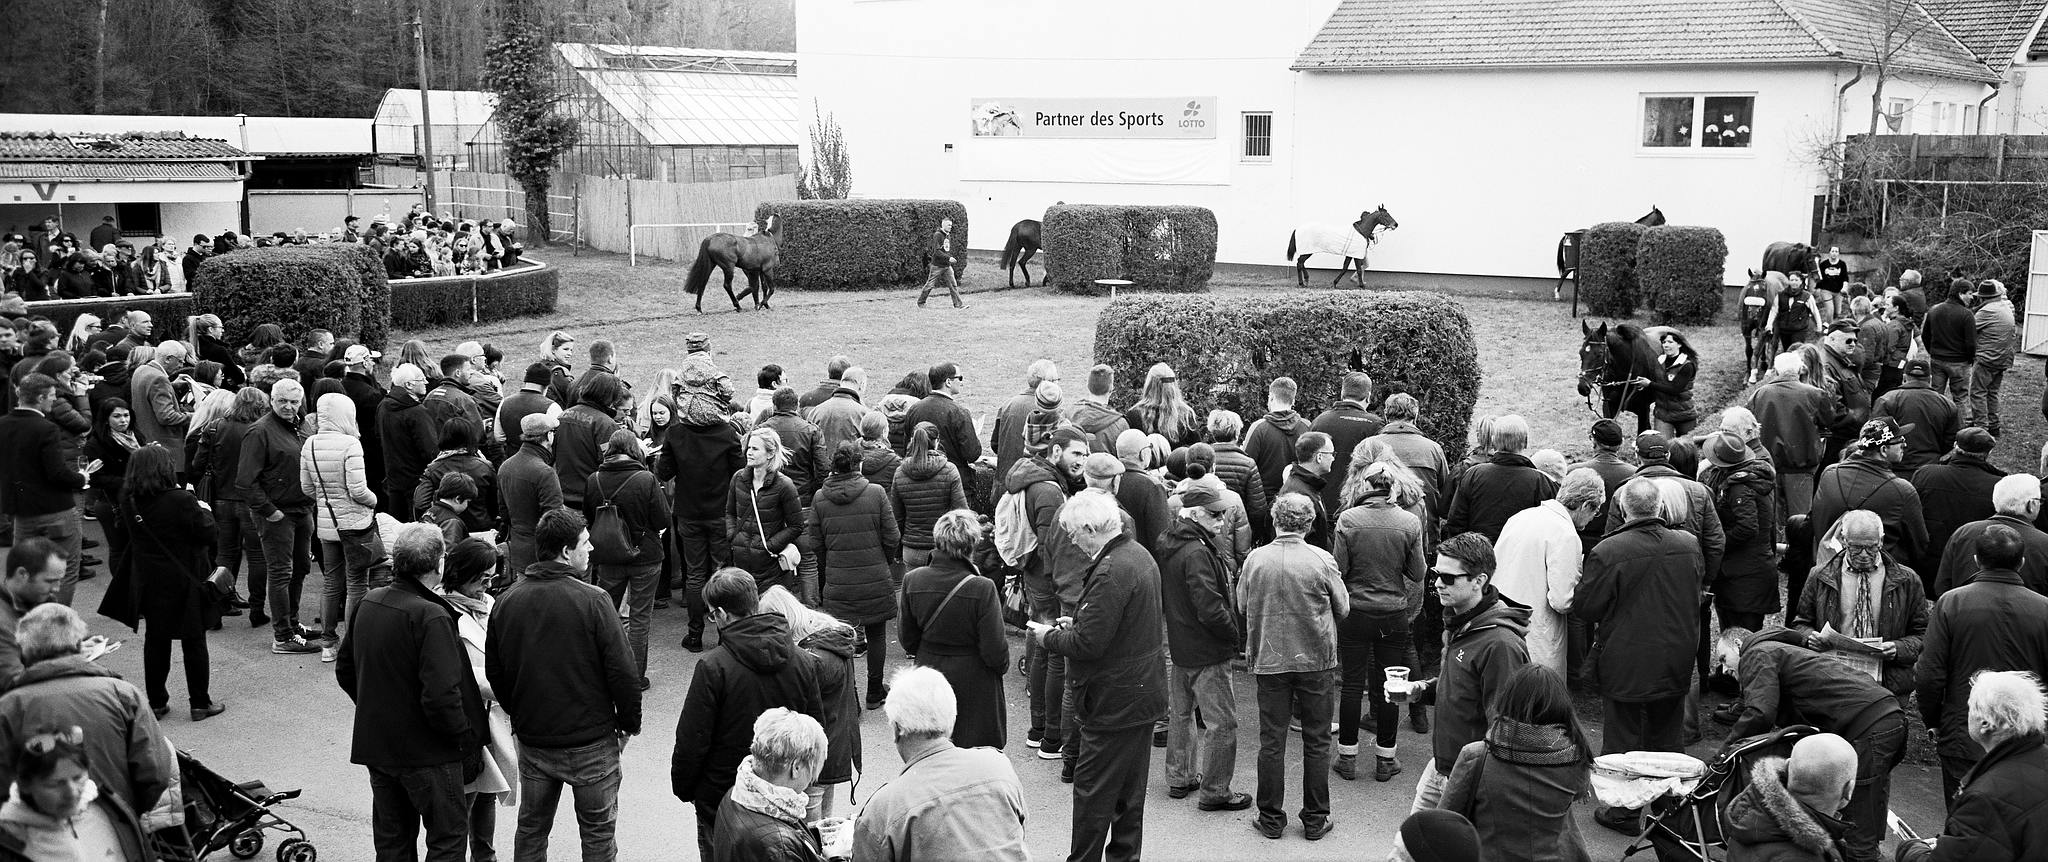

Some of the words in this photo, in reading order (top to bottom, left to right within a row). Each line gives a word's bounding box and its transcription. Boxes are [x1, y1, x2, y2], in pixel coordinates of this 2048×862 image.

[1035, 111, 1085, 127] Partner
[1090, 110, 1114, 127] des
[1118, 111, 1164, 130] Sports
[1178, 119, 1206, 128] LOTTO
